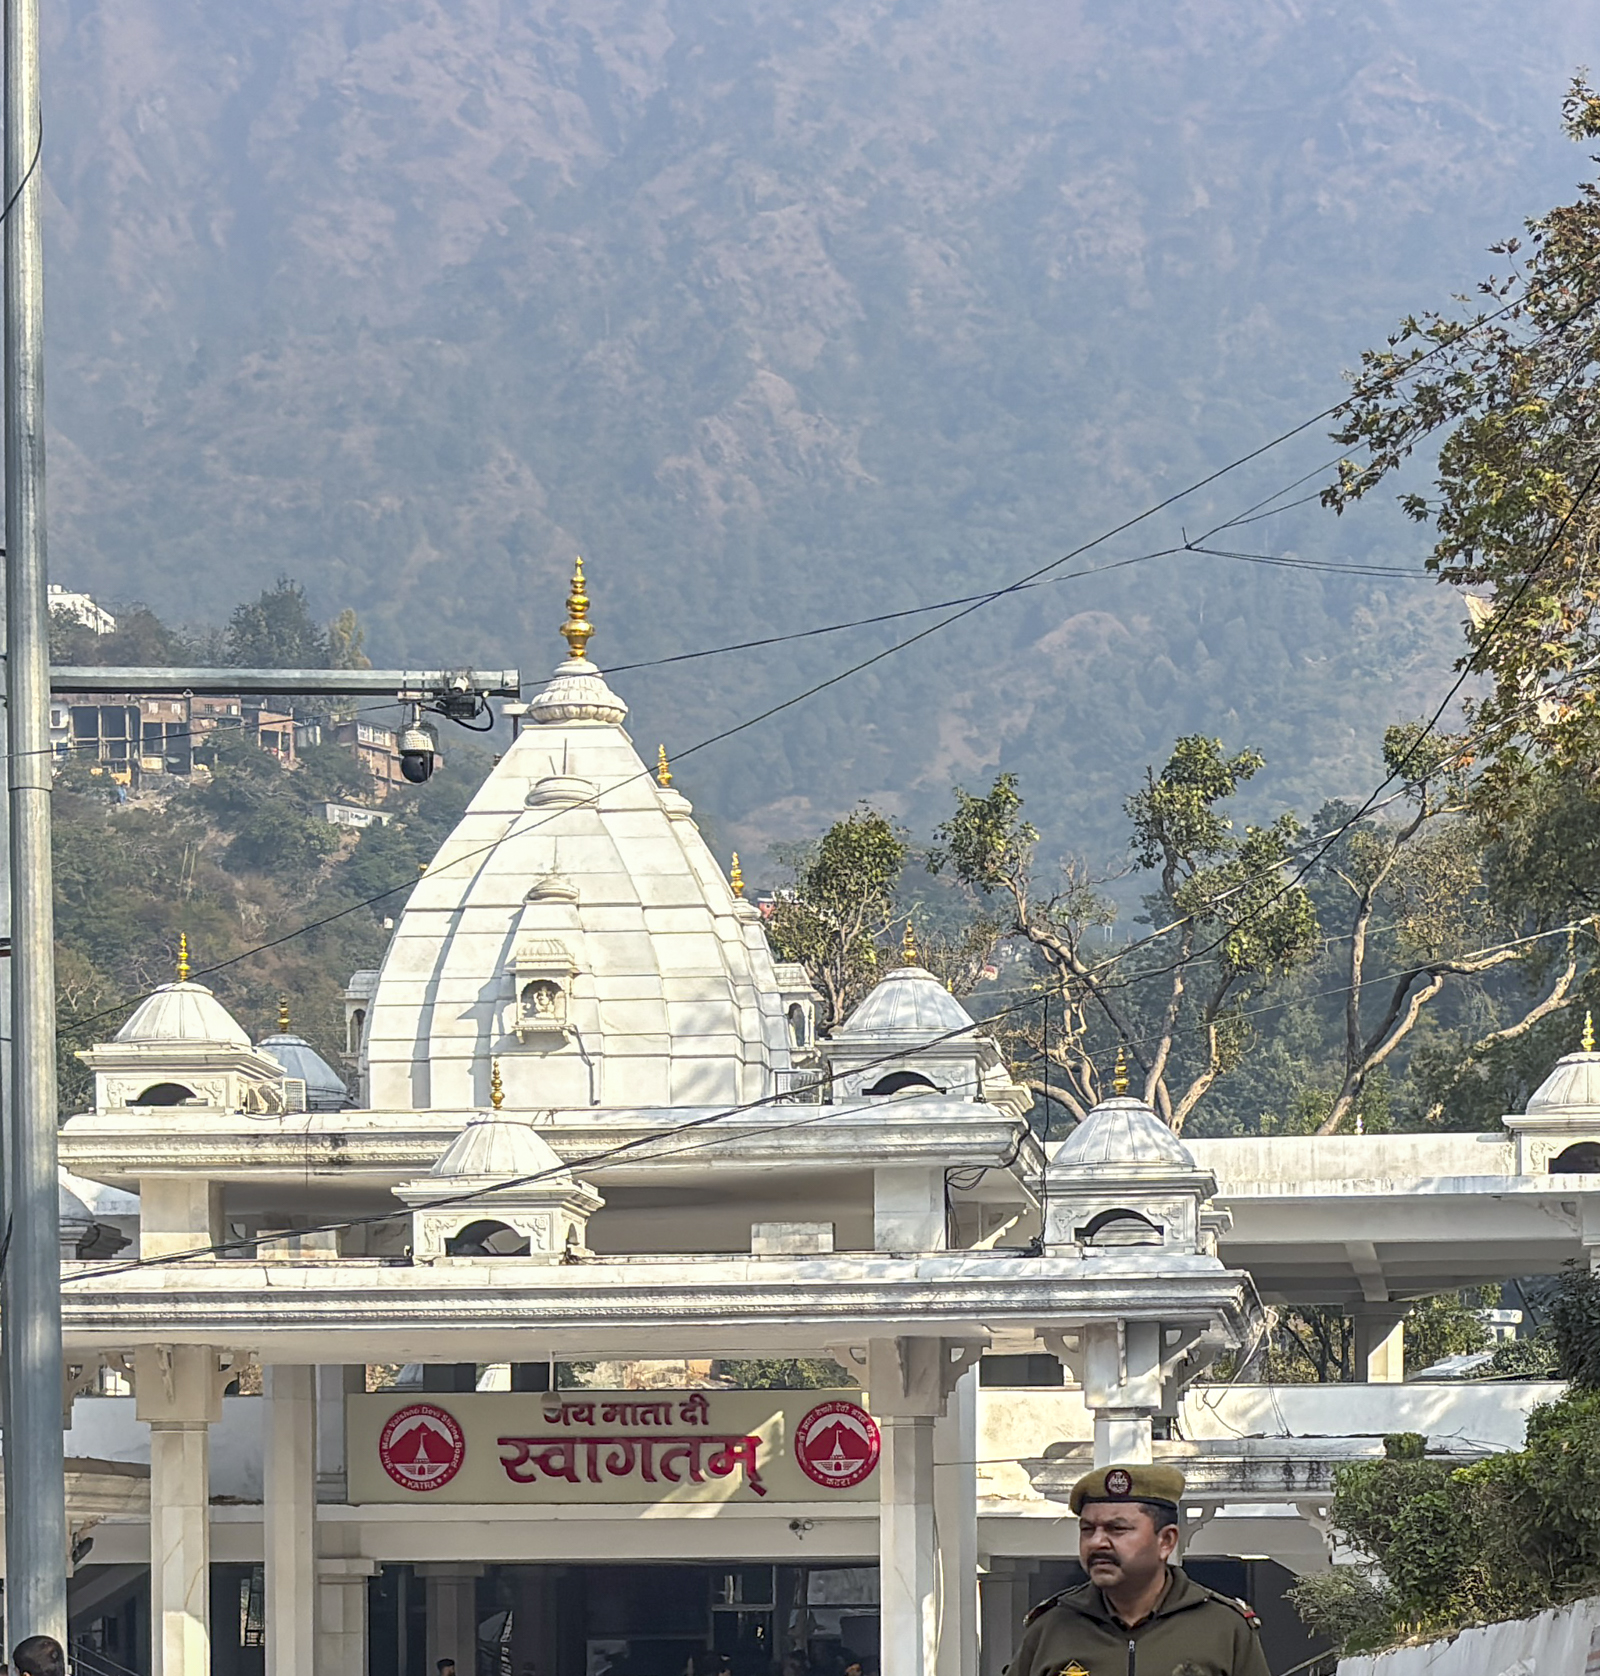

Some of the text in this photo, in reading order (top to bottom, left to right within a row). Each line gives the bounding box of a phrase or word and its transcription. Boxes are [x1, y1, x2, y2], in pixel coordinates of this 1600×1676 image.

[421, 1406, 441, 1418] Devi
[440, 1414, 460, 1440] Shrine
[601, 1401, 673, 1426] माता
[678, 1393, 711, 1426] दी
[496, 1435, 767, 1497] स्वागतम्
[406, 1480, 438, 1490] KATRA
